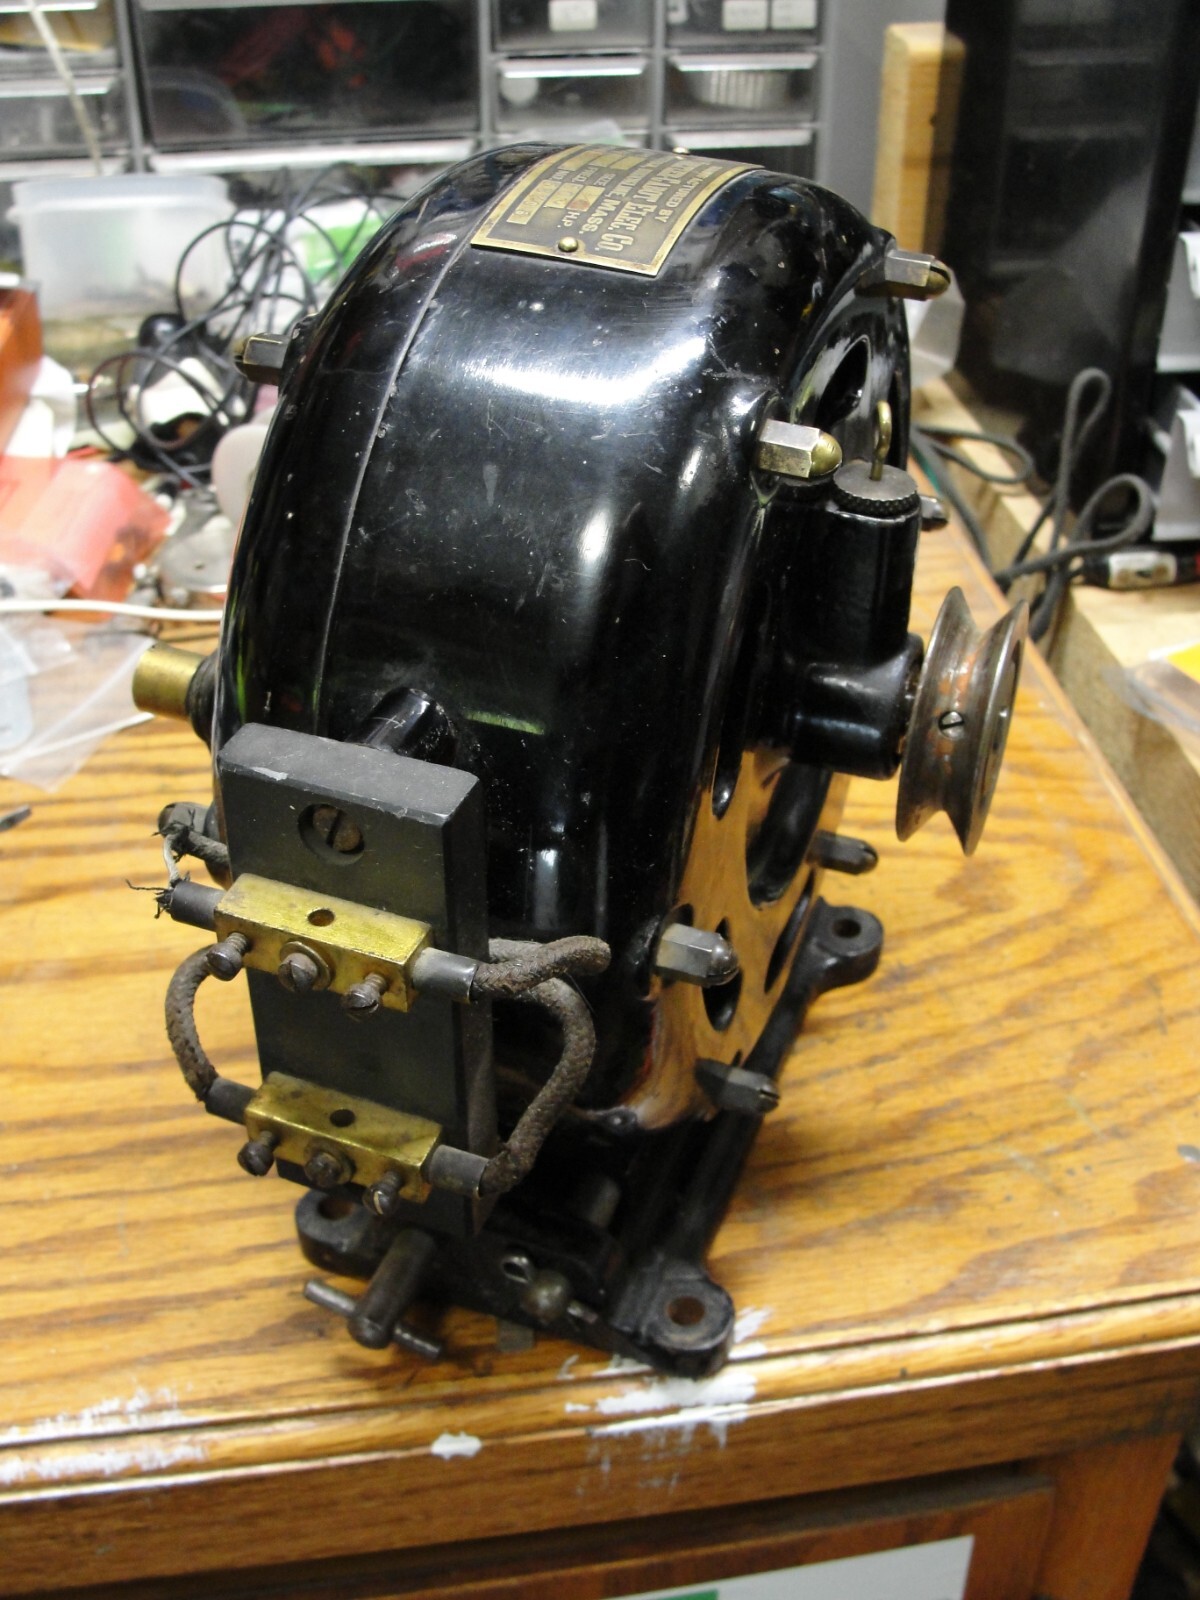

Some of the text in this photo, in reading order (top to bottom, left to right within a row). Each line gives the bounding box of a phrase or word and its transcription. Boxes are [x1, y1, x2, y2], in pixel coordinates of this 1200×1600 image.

[557, 210, 580, 228] H.P.
[578, 198, 621, 234] MASS.
[607, 201, 658, 231] ELEC.
[654, 208, 674, 222] BY
[594, 232, 635, 251] CO.
